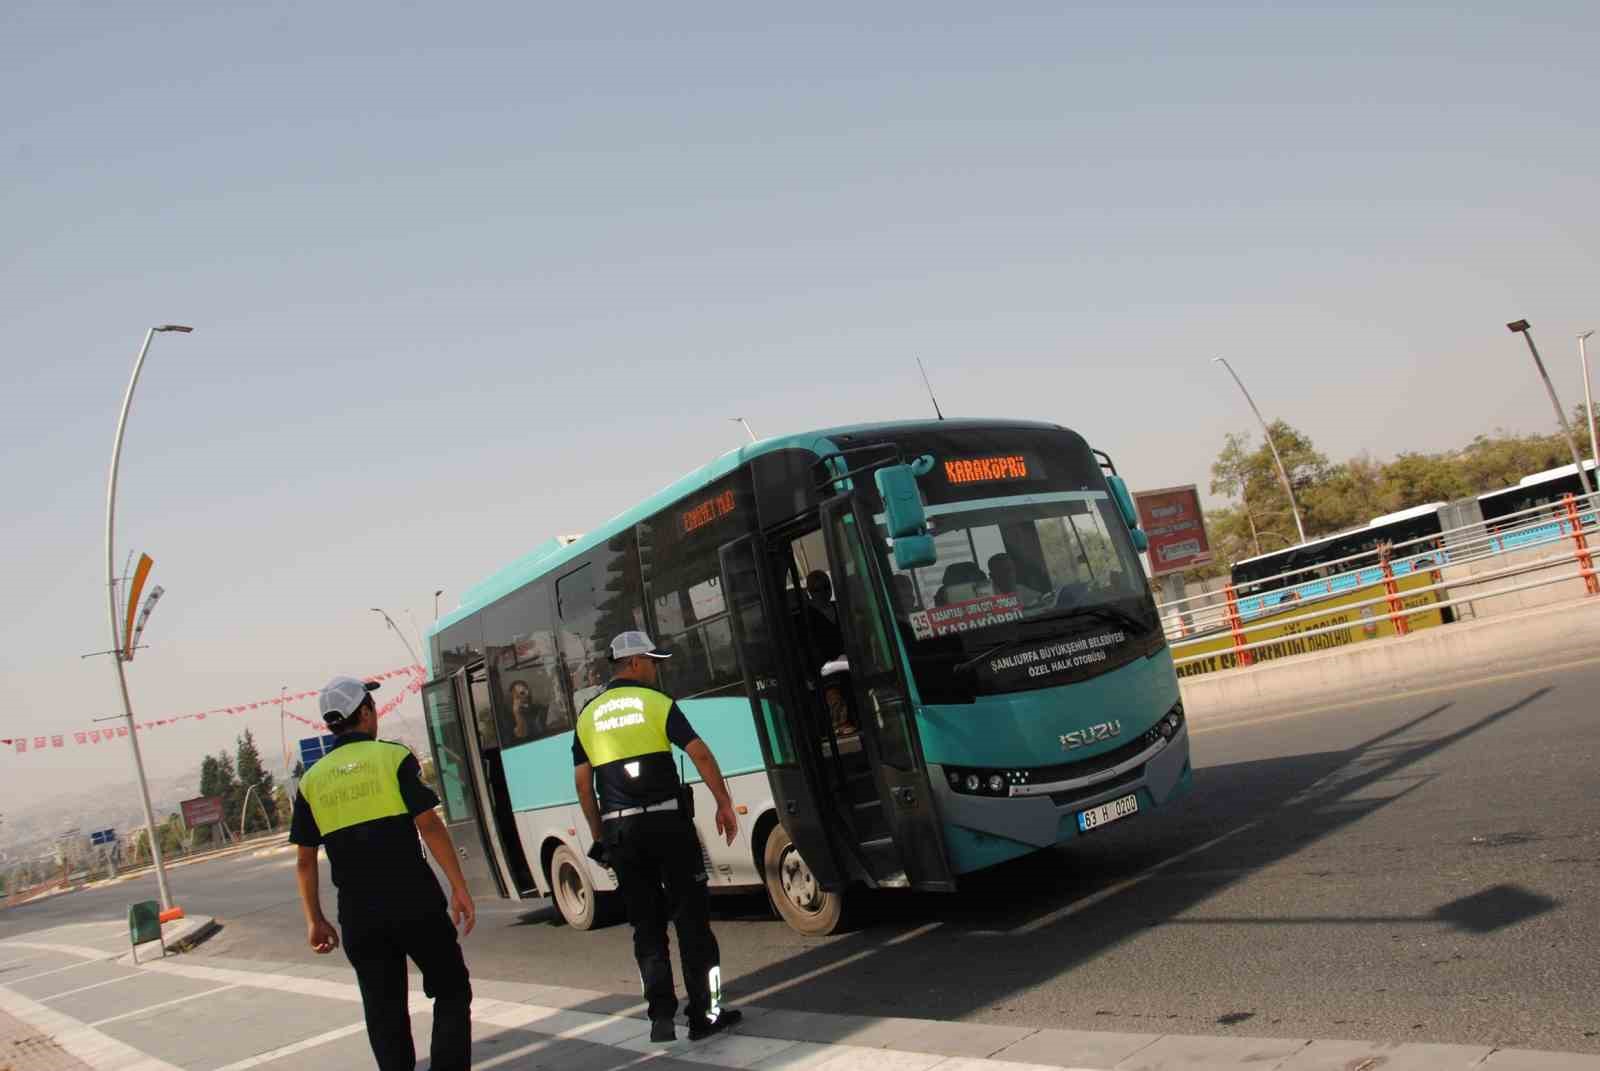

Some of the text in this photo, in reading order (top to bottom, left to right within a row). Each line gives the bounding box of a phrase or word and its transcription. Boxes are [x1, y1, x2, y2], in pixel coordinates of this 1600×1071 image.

[944, 456, 1028, 484] KARAKÖPRÜ
[911, 613, 930, 632] 35
[990, 630, 1126, 673] ŞANLIURFA BÜYÜKŞEHİR BELEDİYESİ
[1028, 649, 1106, 677] ÖZEL HALK OTOBÜSÜ
[1058, 719, 1121, 750] ISUZU
[1085, 796, 1136, 827] 63 H 0200
